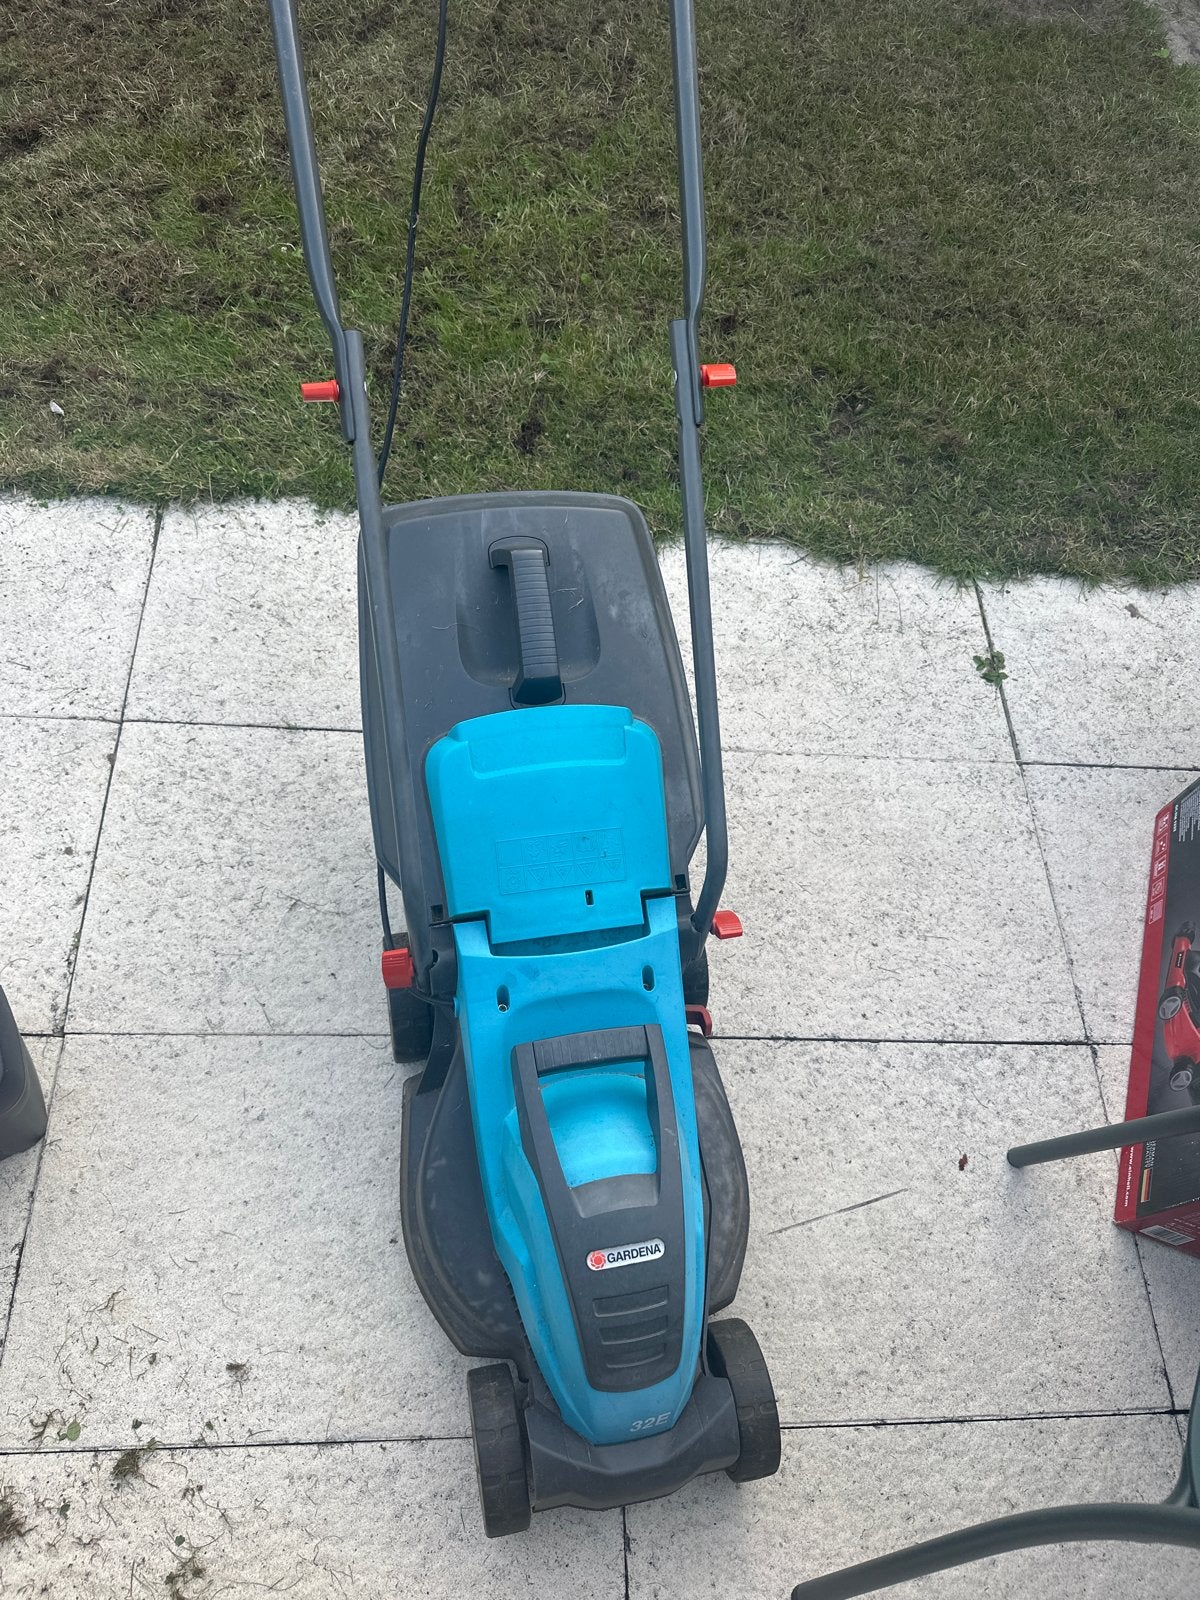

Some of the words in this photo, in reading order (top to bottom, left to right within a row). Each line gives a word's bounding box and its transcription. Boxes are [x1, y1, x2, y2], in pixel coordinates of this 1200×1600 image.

[1124, 1146, 1134, 1207] www.einhell.com
[607, 1244, 661, 1263] GARDENA
[630, 1411, 671, 1432] 32E
